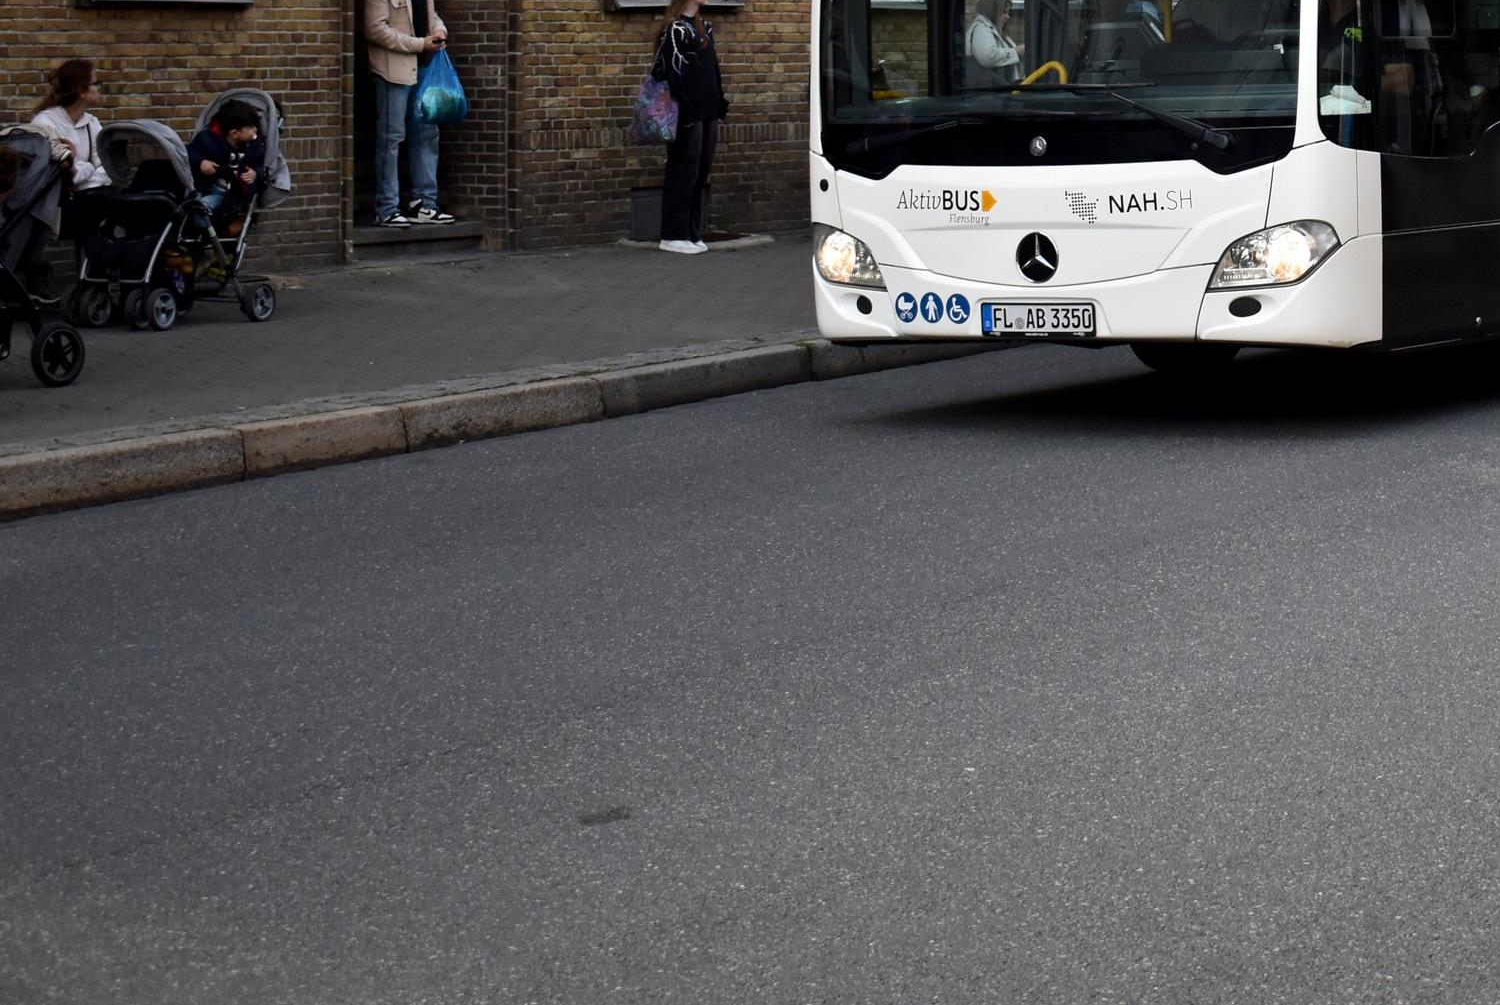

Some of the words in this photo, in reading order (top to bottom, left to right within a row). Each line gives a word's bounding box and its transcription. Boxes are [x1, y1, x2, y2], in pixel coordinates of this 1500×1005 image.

[896, 189, 980, 211] AktivBUS
[1108, 189, 1193, 214] NAH.SH
[949, 213, 989, 227] Flensburg
[993, 308, 1013, 329] FL
[1026, 308, 1046, 329] AB
[1051, 308, 1092, 329] 3350
